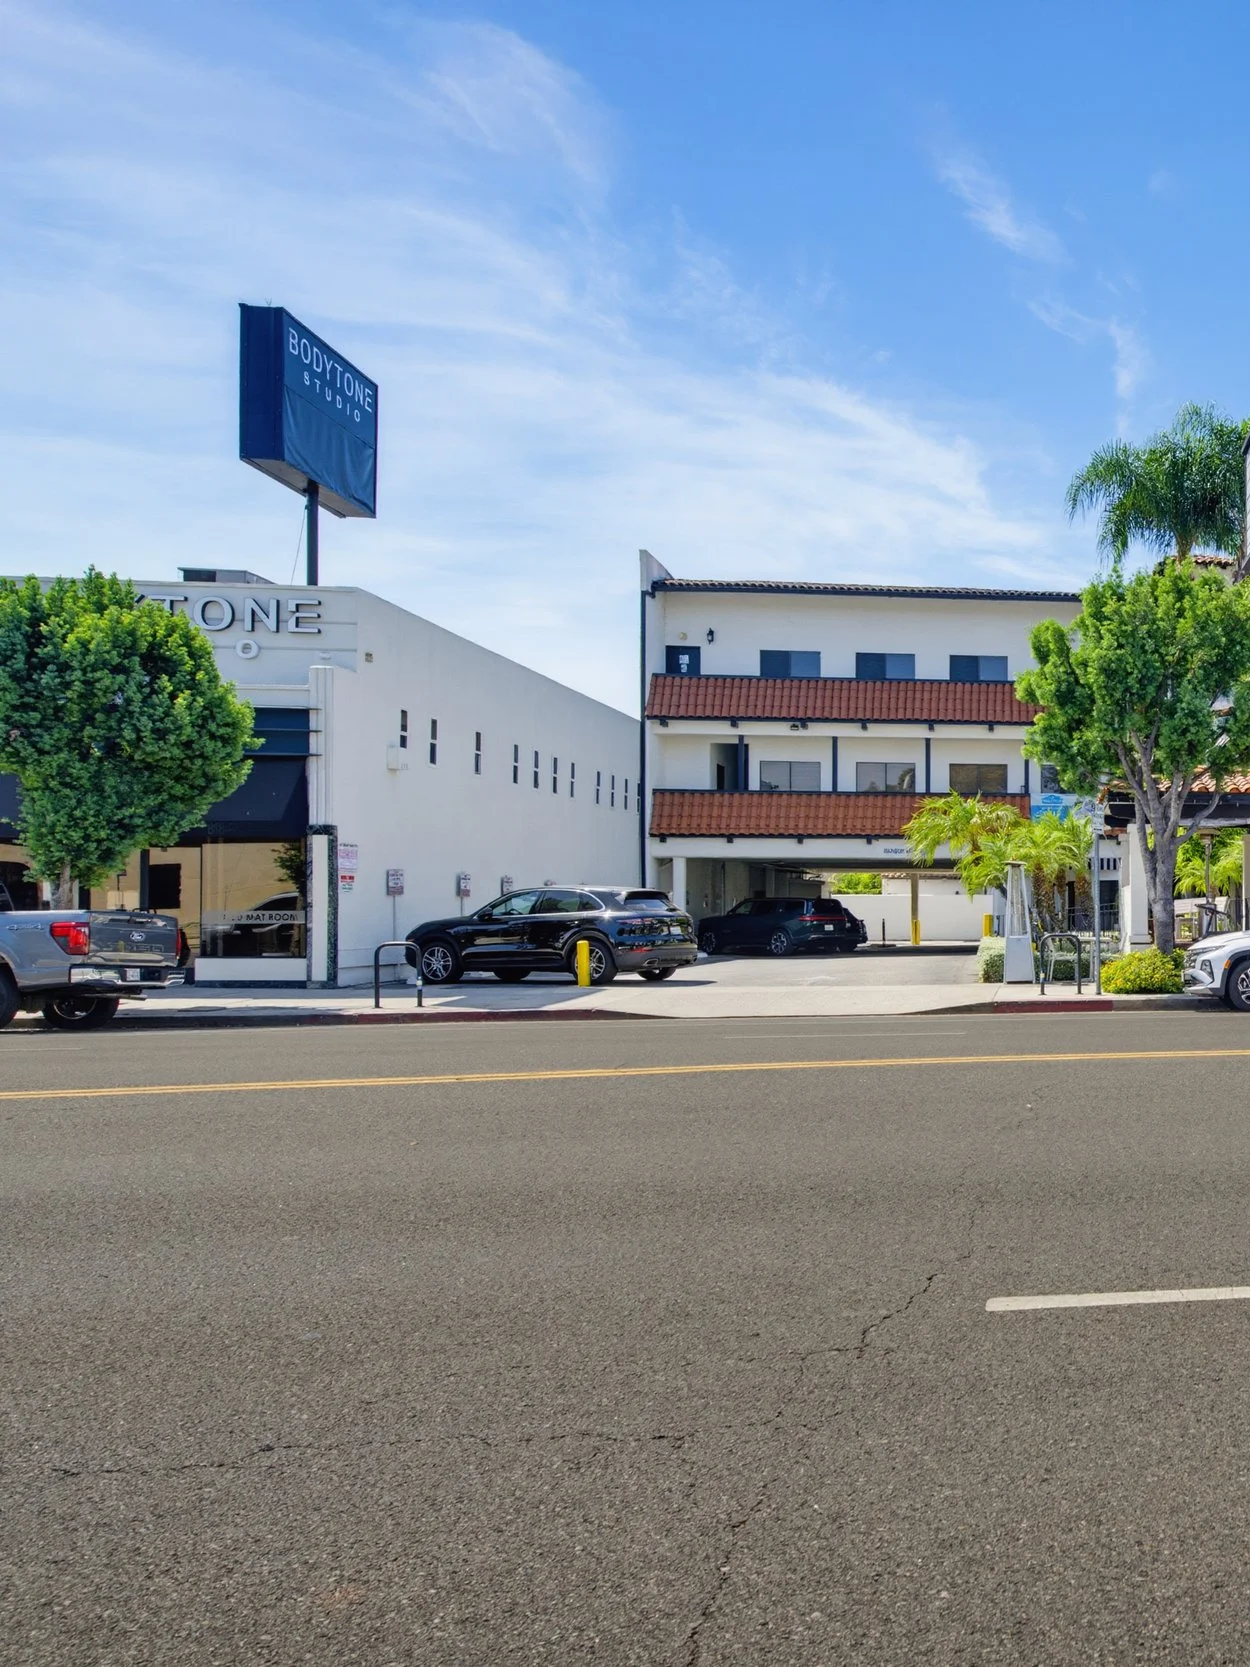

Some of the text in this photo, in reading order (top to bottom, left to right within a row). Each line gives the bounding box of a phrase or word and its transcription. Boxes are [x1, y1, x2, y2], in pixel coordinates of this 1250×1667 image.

[288, 327, 373, 412] BODYTONE
[303, 371, 361, 422] STUDIO
[135, 594, 322, 634] TONE
